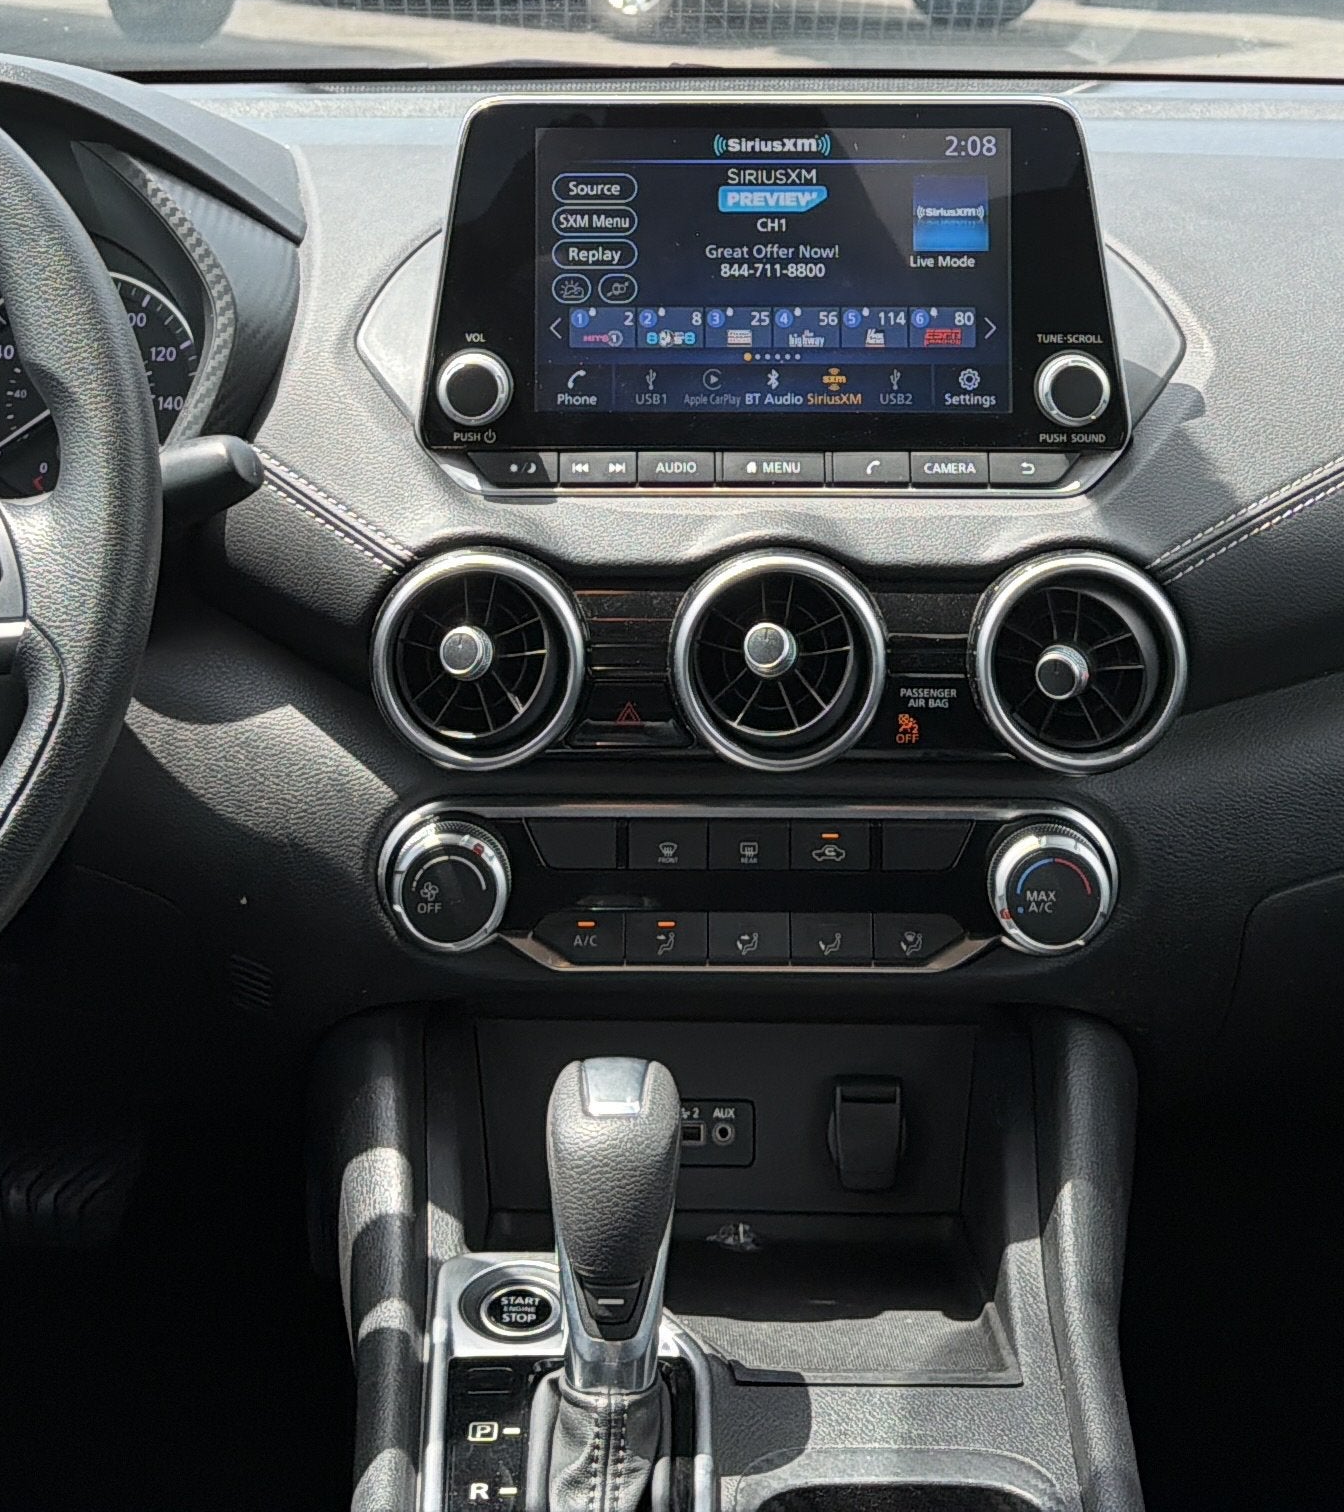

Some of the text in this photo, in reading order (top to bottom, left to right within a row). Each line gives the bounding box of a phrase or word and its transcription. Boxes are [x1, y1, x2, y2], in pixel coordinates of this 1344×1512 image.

[944, 135, 997, 156] 2:08
[727, 169, 817, 184] SIRIUSXM
[568, 181, 621, 196] Source
[727, 191, 819, 207] PREVIEW
[559, 214, 630, 229] SXM Menu
[756, 218, 787, 232] CH1
[568, 247, 622, 265] Replay
[705, 245, 839, 259] Great Offer Now!
[909, 256, 976, 268] Live Mode
[720, 263, 826, 279] 844-711-8800
[623, 311, 634, 326] 2
[691, 311, 702, 326] 8
[750, 311, 770, 326] 25
[819, 311, 838, 326] 56
[878, 311, 906, 326] 114
[954, 311, 975, 326] 80
[465, 332, 486, 343] VOL
[788, 333, 825, 347] highway
[150, 346, 177, 362] 120
[157, 395, 184, 411] 140
[557, 393, 598, 405] Phone
[635, 393, 667, 404] USB1
[684, 393, 741, 406] Apple CarPlay
[745, 393, 803, 405] BT Audio
[807, 393, 862, 405] SiriusXM
[879, 394, 913, 405] USB2
[944, 393, 997, 408] Settings
[453, 432, 481, 442] PUSH
[1039, 433, 1106, 443] PUSH SOUND
[655, 461, 697, 474] AUDIO
[762, 461, 801, 474] MENU
[923, 462, 976, 474] CAMERA
[899, 687, 957, 698] PASSENGER
[907, 698, 949, 708] AIR BAG
[895, 734, 920, 744] OFF
[1026, 890, 1056, 902] MAX
[417, 902, 442, 914] OFF
[1028, 902, 1053, 914] A/C
[573, 934, 598, 948] A/C
[712, 1107, 736, 1119] AUX
[500, 1295, 541, 1307] START
[502, 1312, 537, 1325] STOP
[469, 1483, 489, 1500] R
